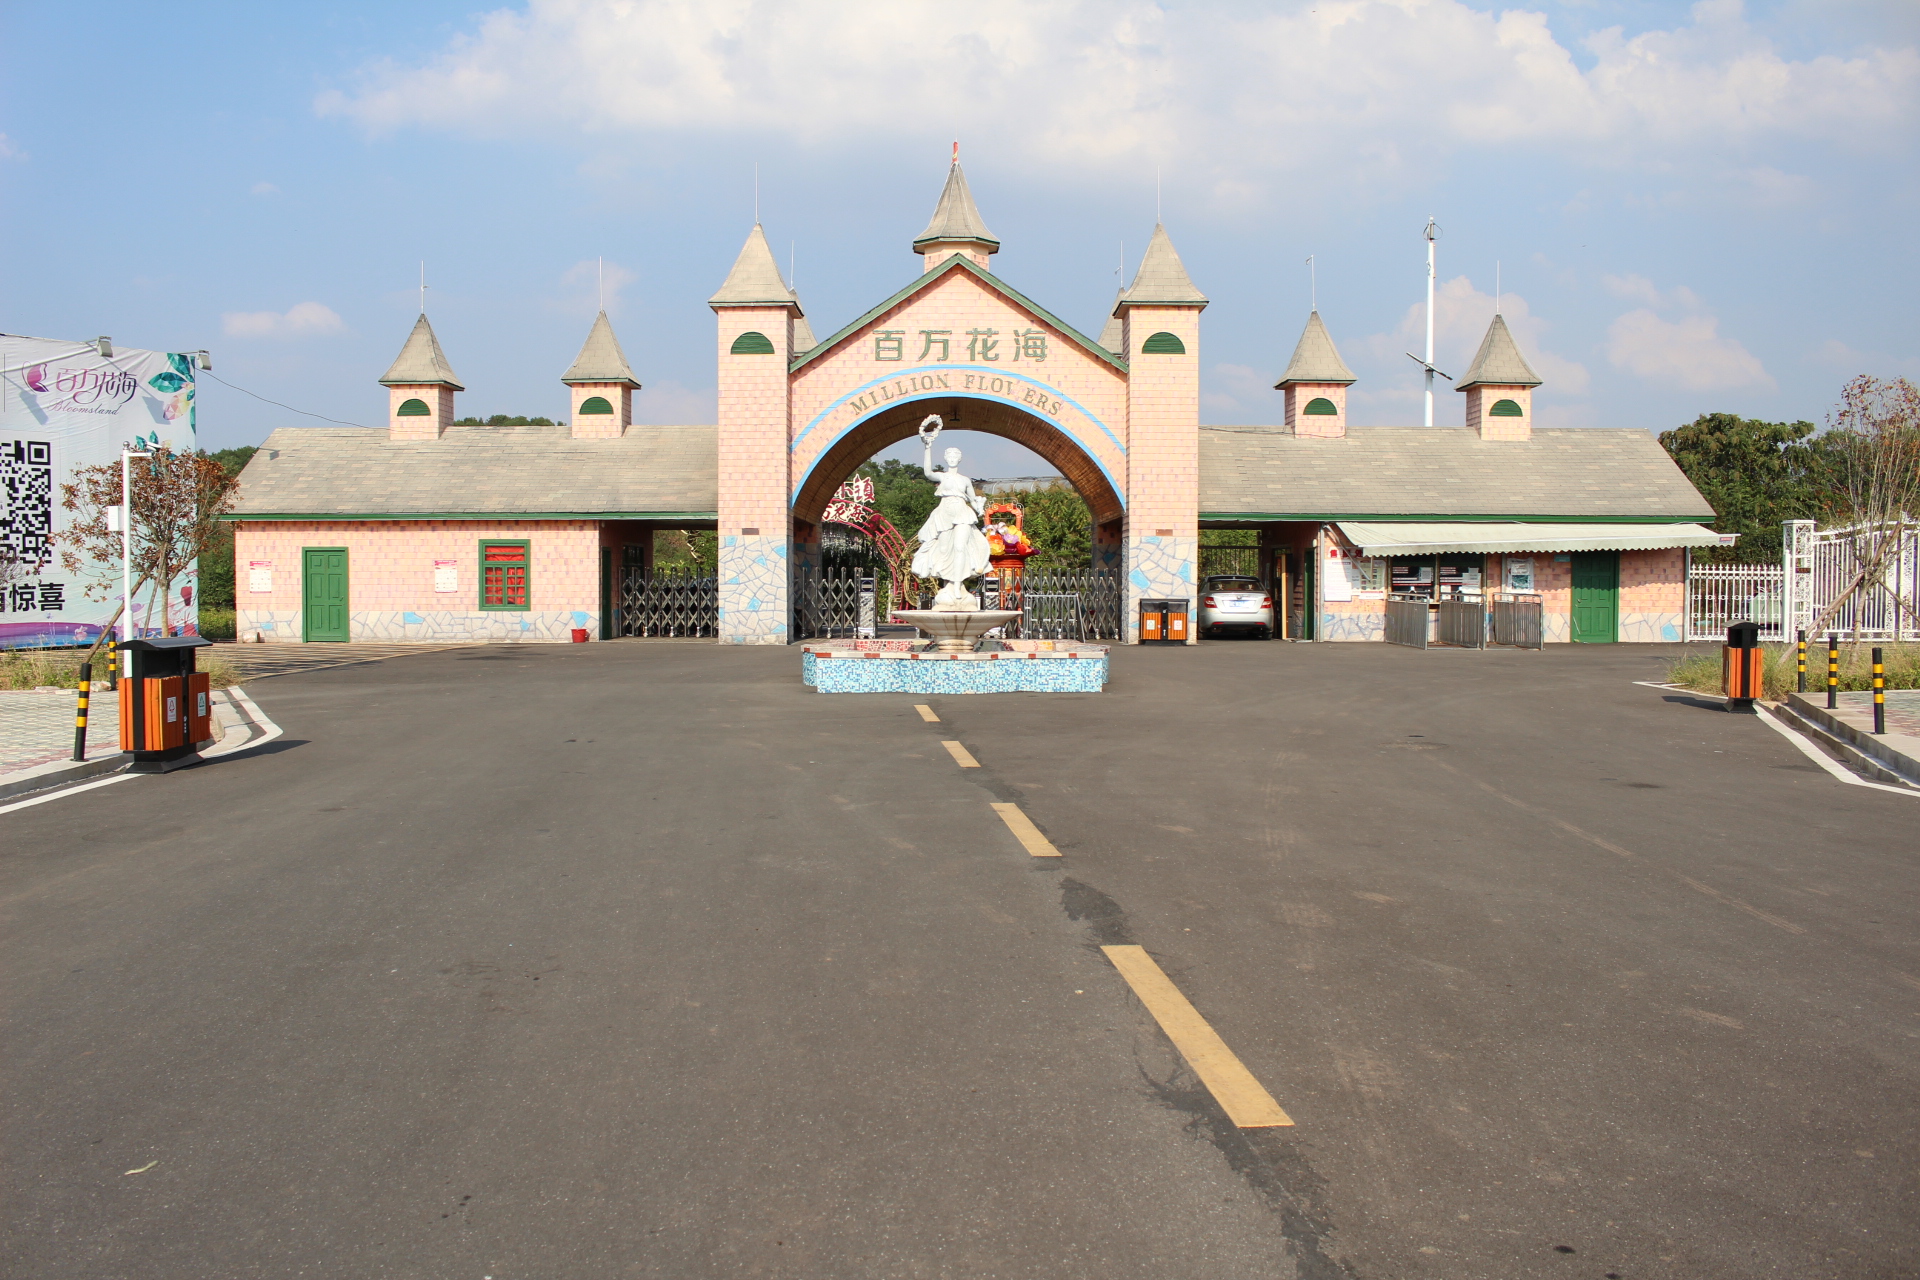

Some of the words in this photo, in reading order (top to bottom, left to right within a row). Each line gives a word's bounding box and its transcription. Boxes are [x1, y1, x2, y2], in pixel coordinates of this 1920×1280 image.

[872, 327, 1048, 362] 百万花海
[55, 367, 138, 405] 百万花海
[849, 373, 950, 416] MILLION
[48, 398, 123, 416] Bloomsland
[0, 582, 66, 613] 惊喜
